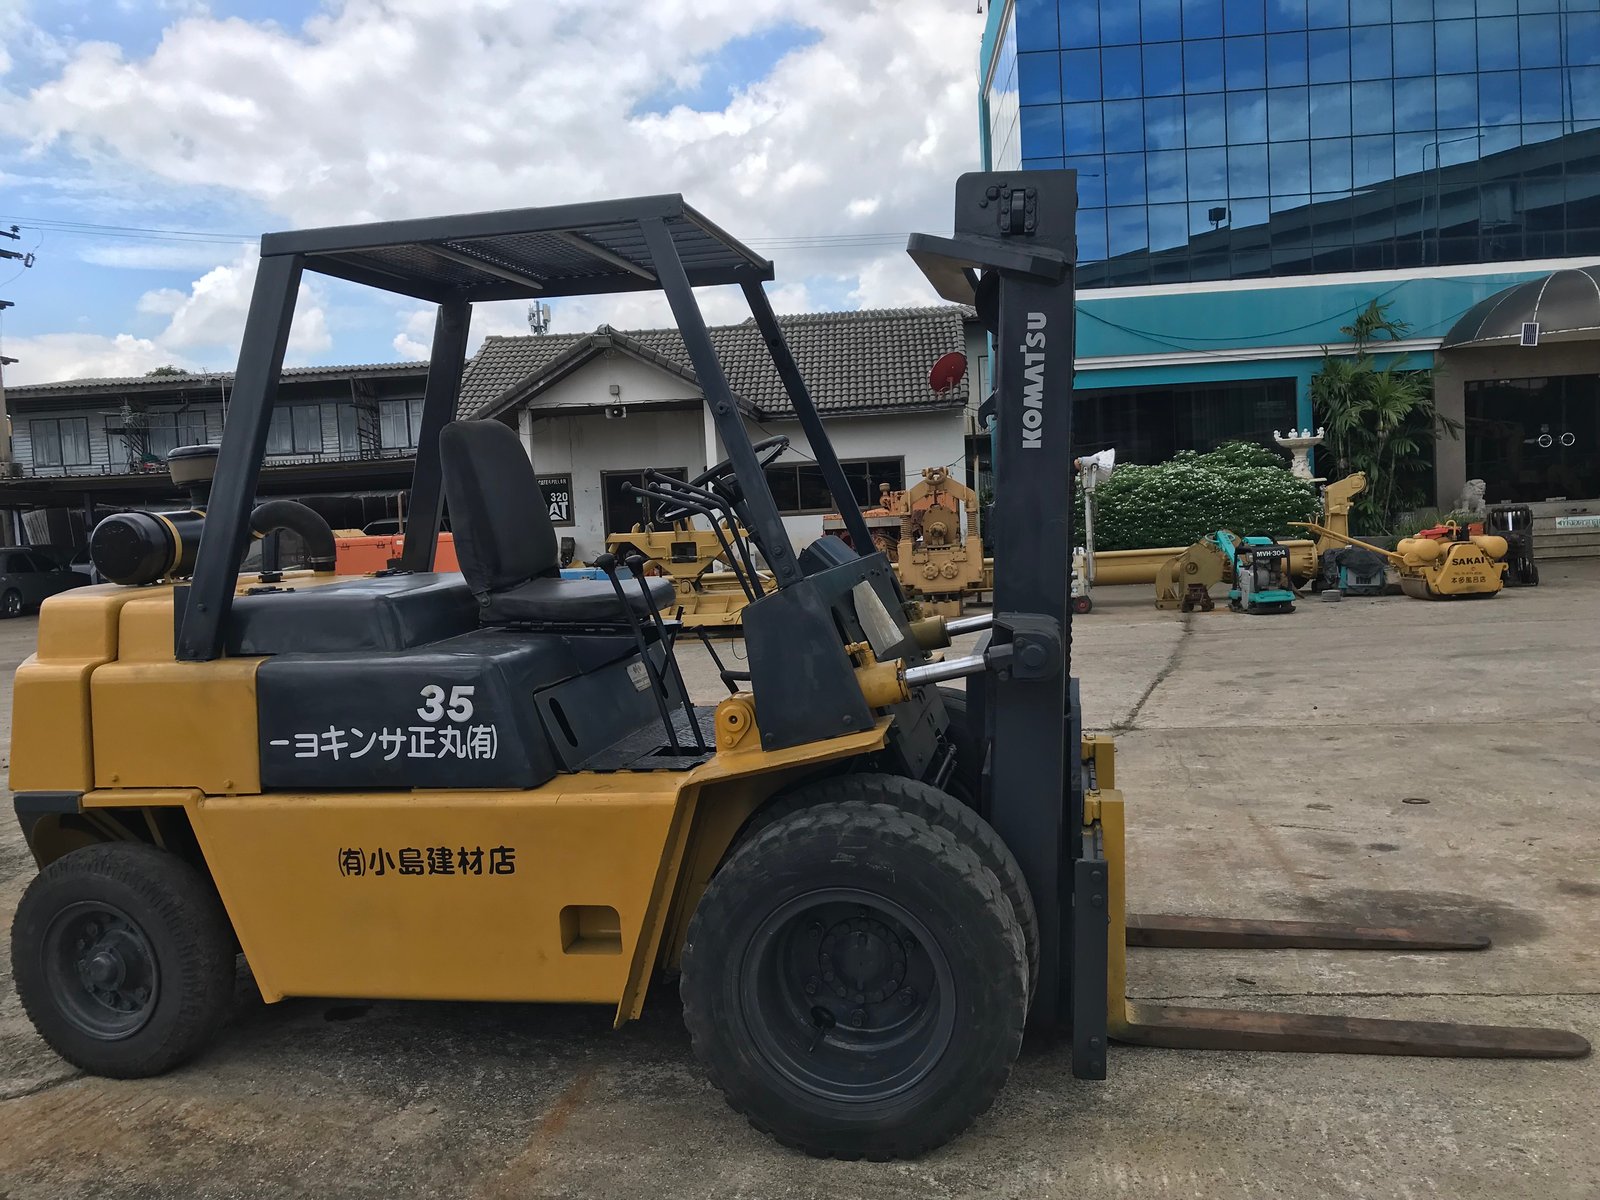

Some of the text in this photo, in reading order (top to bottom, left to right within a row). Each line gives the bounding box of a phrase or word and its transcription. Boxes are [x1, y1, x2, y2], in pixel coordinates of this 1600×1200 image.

[1020, 312, 1047, 448] KOMATSU
[550, 492, 568, 502] 320
[549, 501, 569, 521] AT
[1452, 556, 1485, 566] SAKAI
[416, 684, 475, 723] 35
